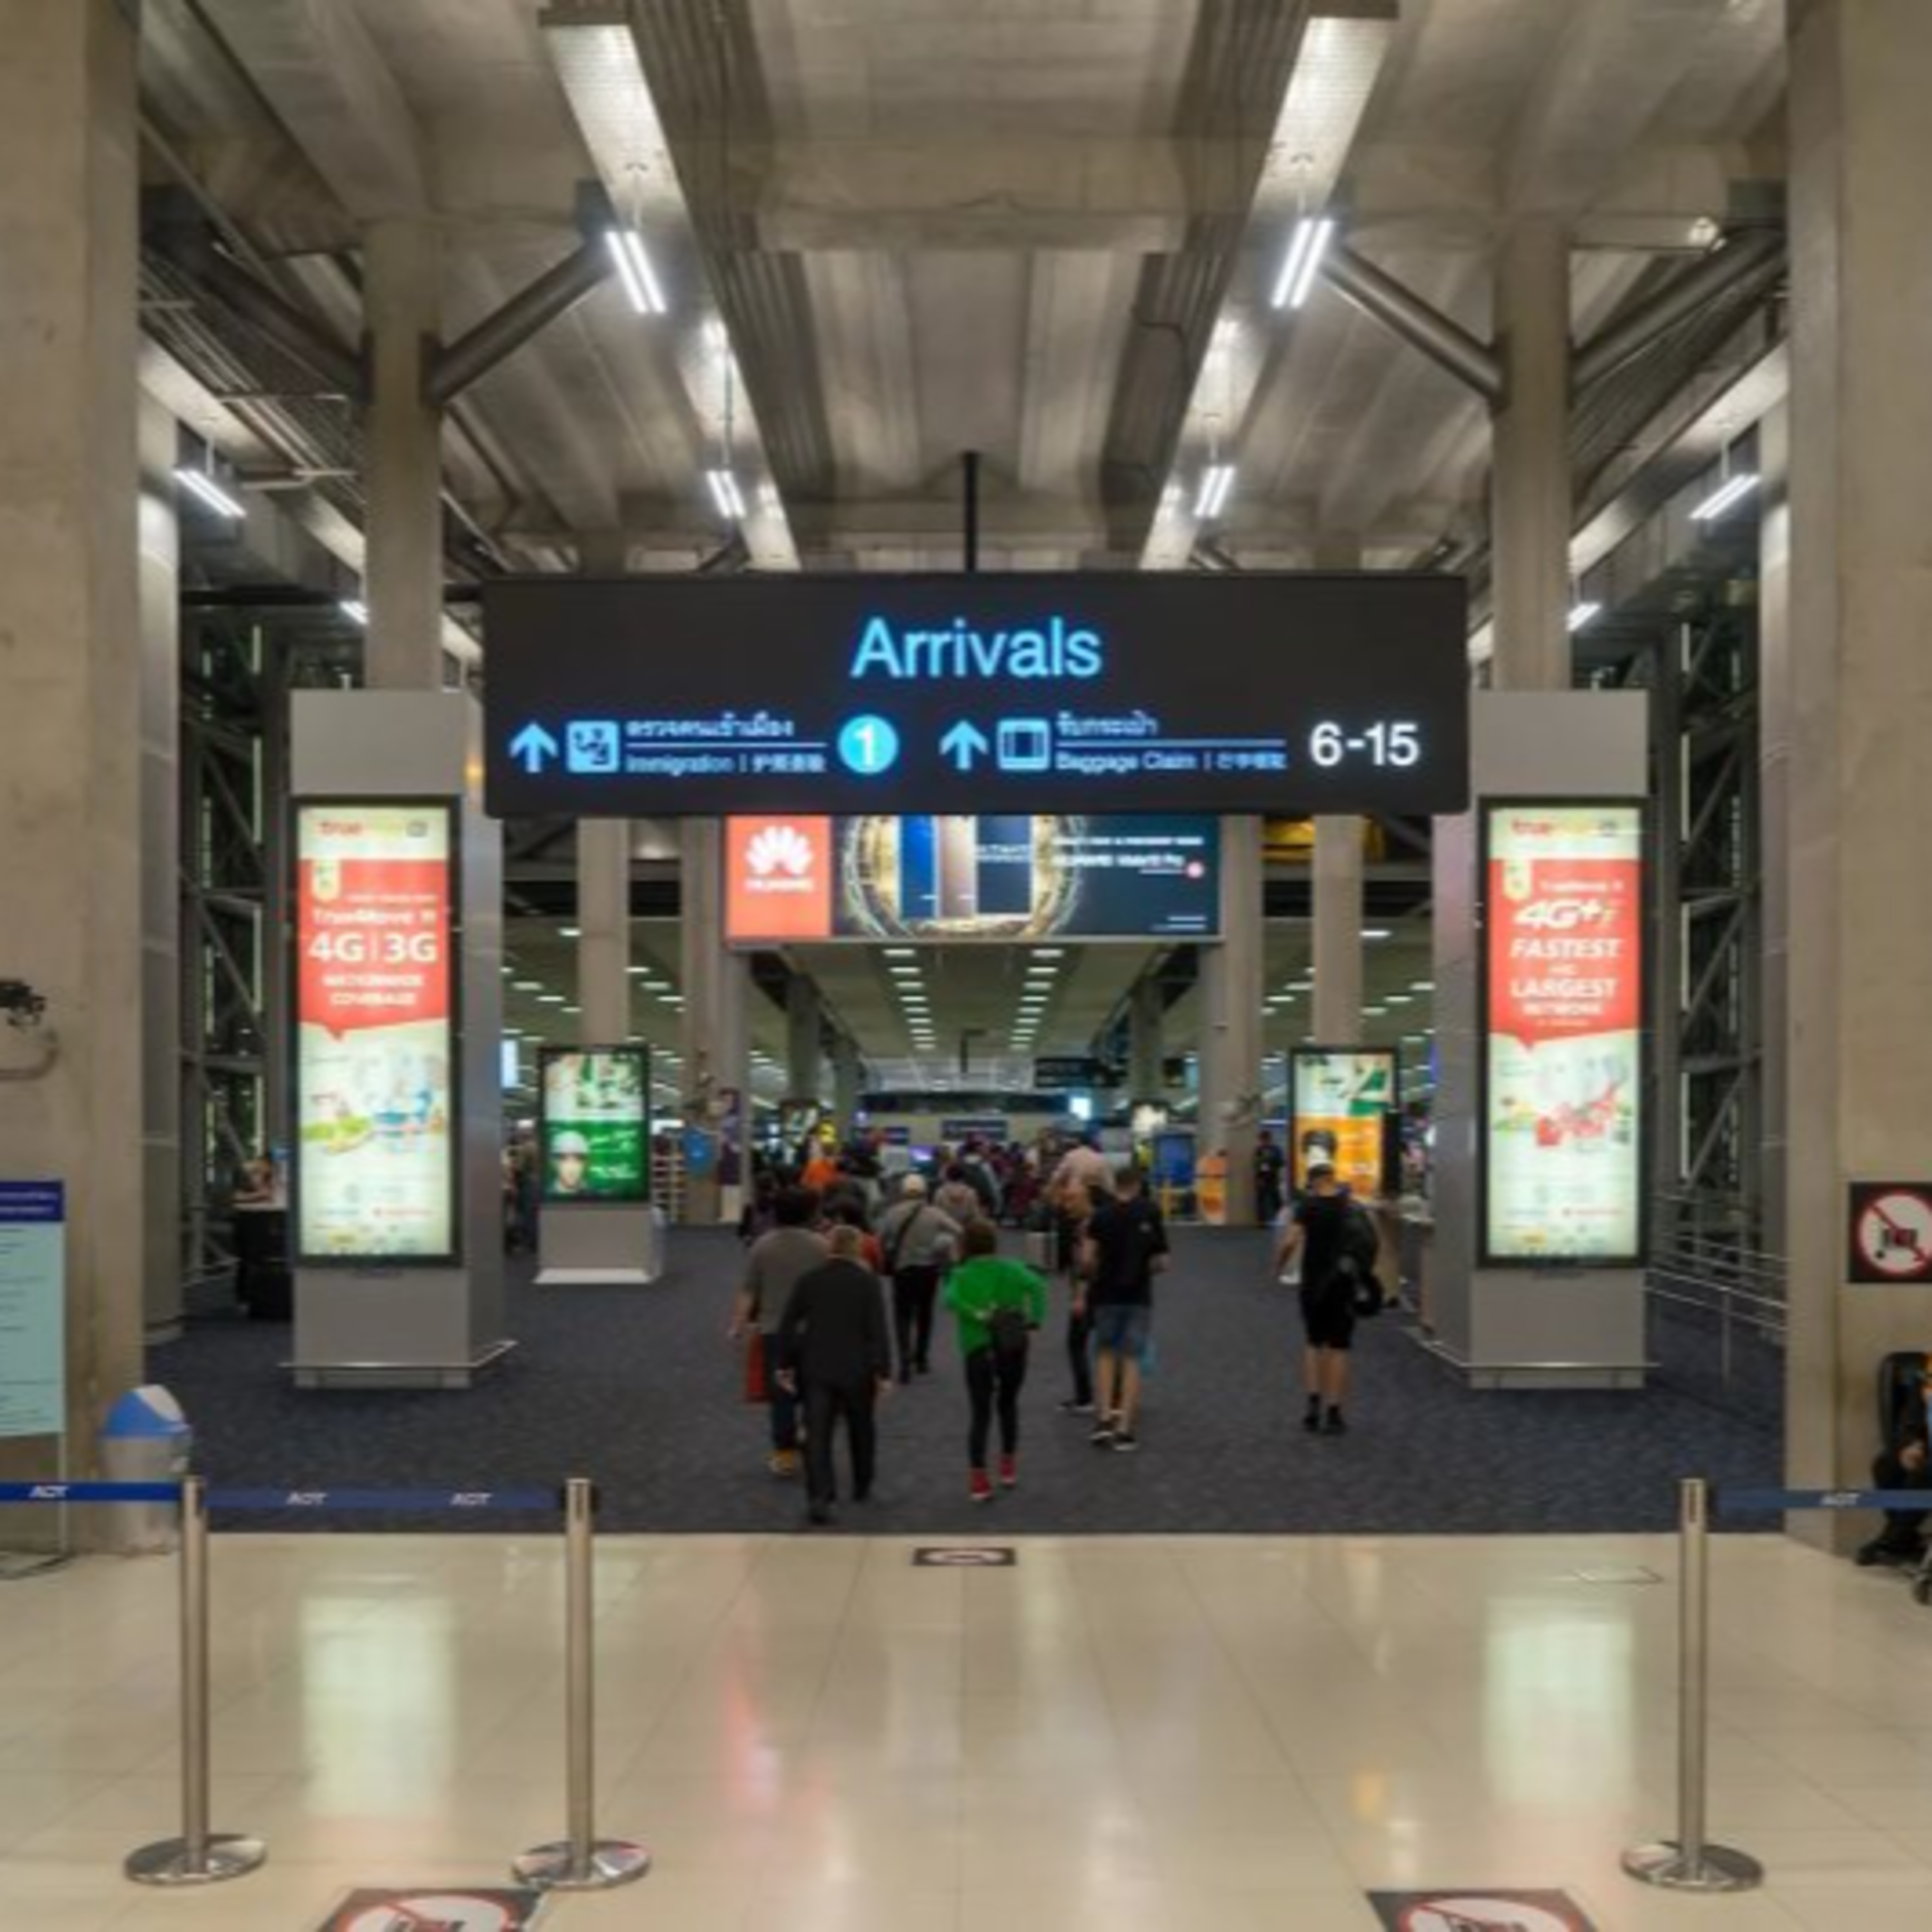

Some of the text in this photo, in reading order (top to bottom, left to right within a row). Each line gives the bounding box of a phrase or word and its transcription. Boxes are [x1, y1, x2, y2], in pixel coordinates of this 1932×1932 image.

[850, 616, 1101, 677] Arrivals
[1310, 721, 1419, 766] 6-15
[1056, 752, 1138, 773] Baggage
[1510, 938, 1624, 958] FASTEST
[1510, 978, 1616, 998] LARGEST
